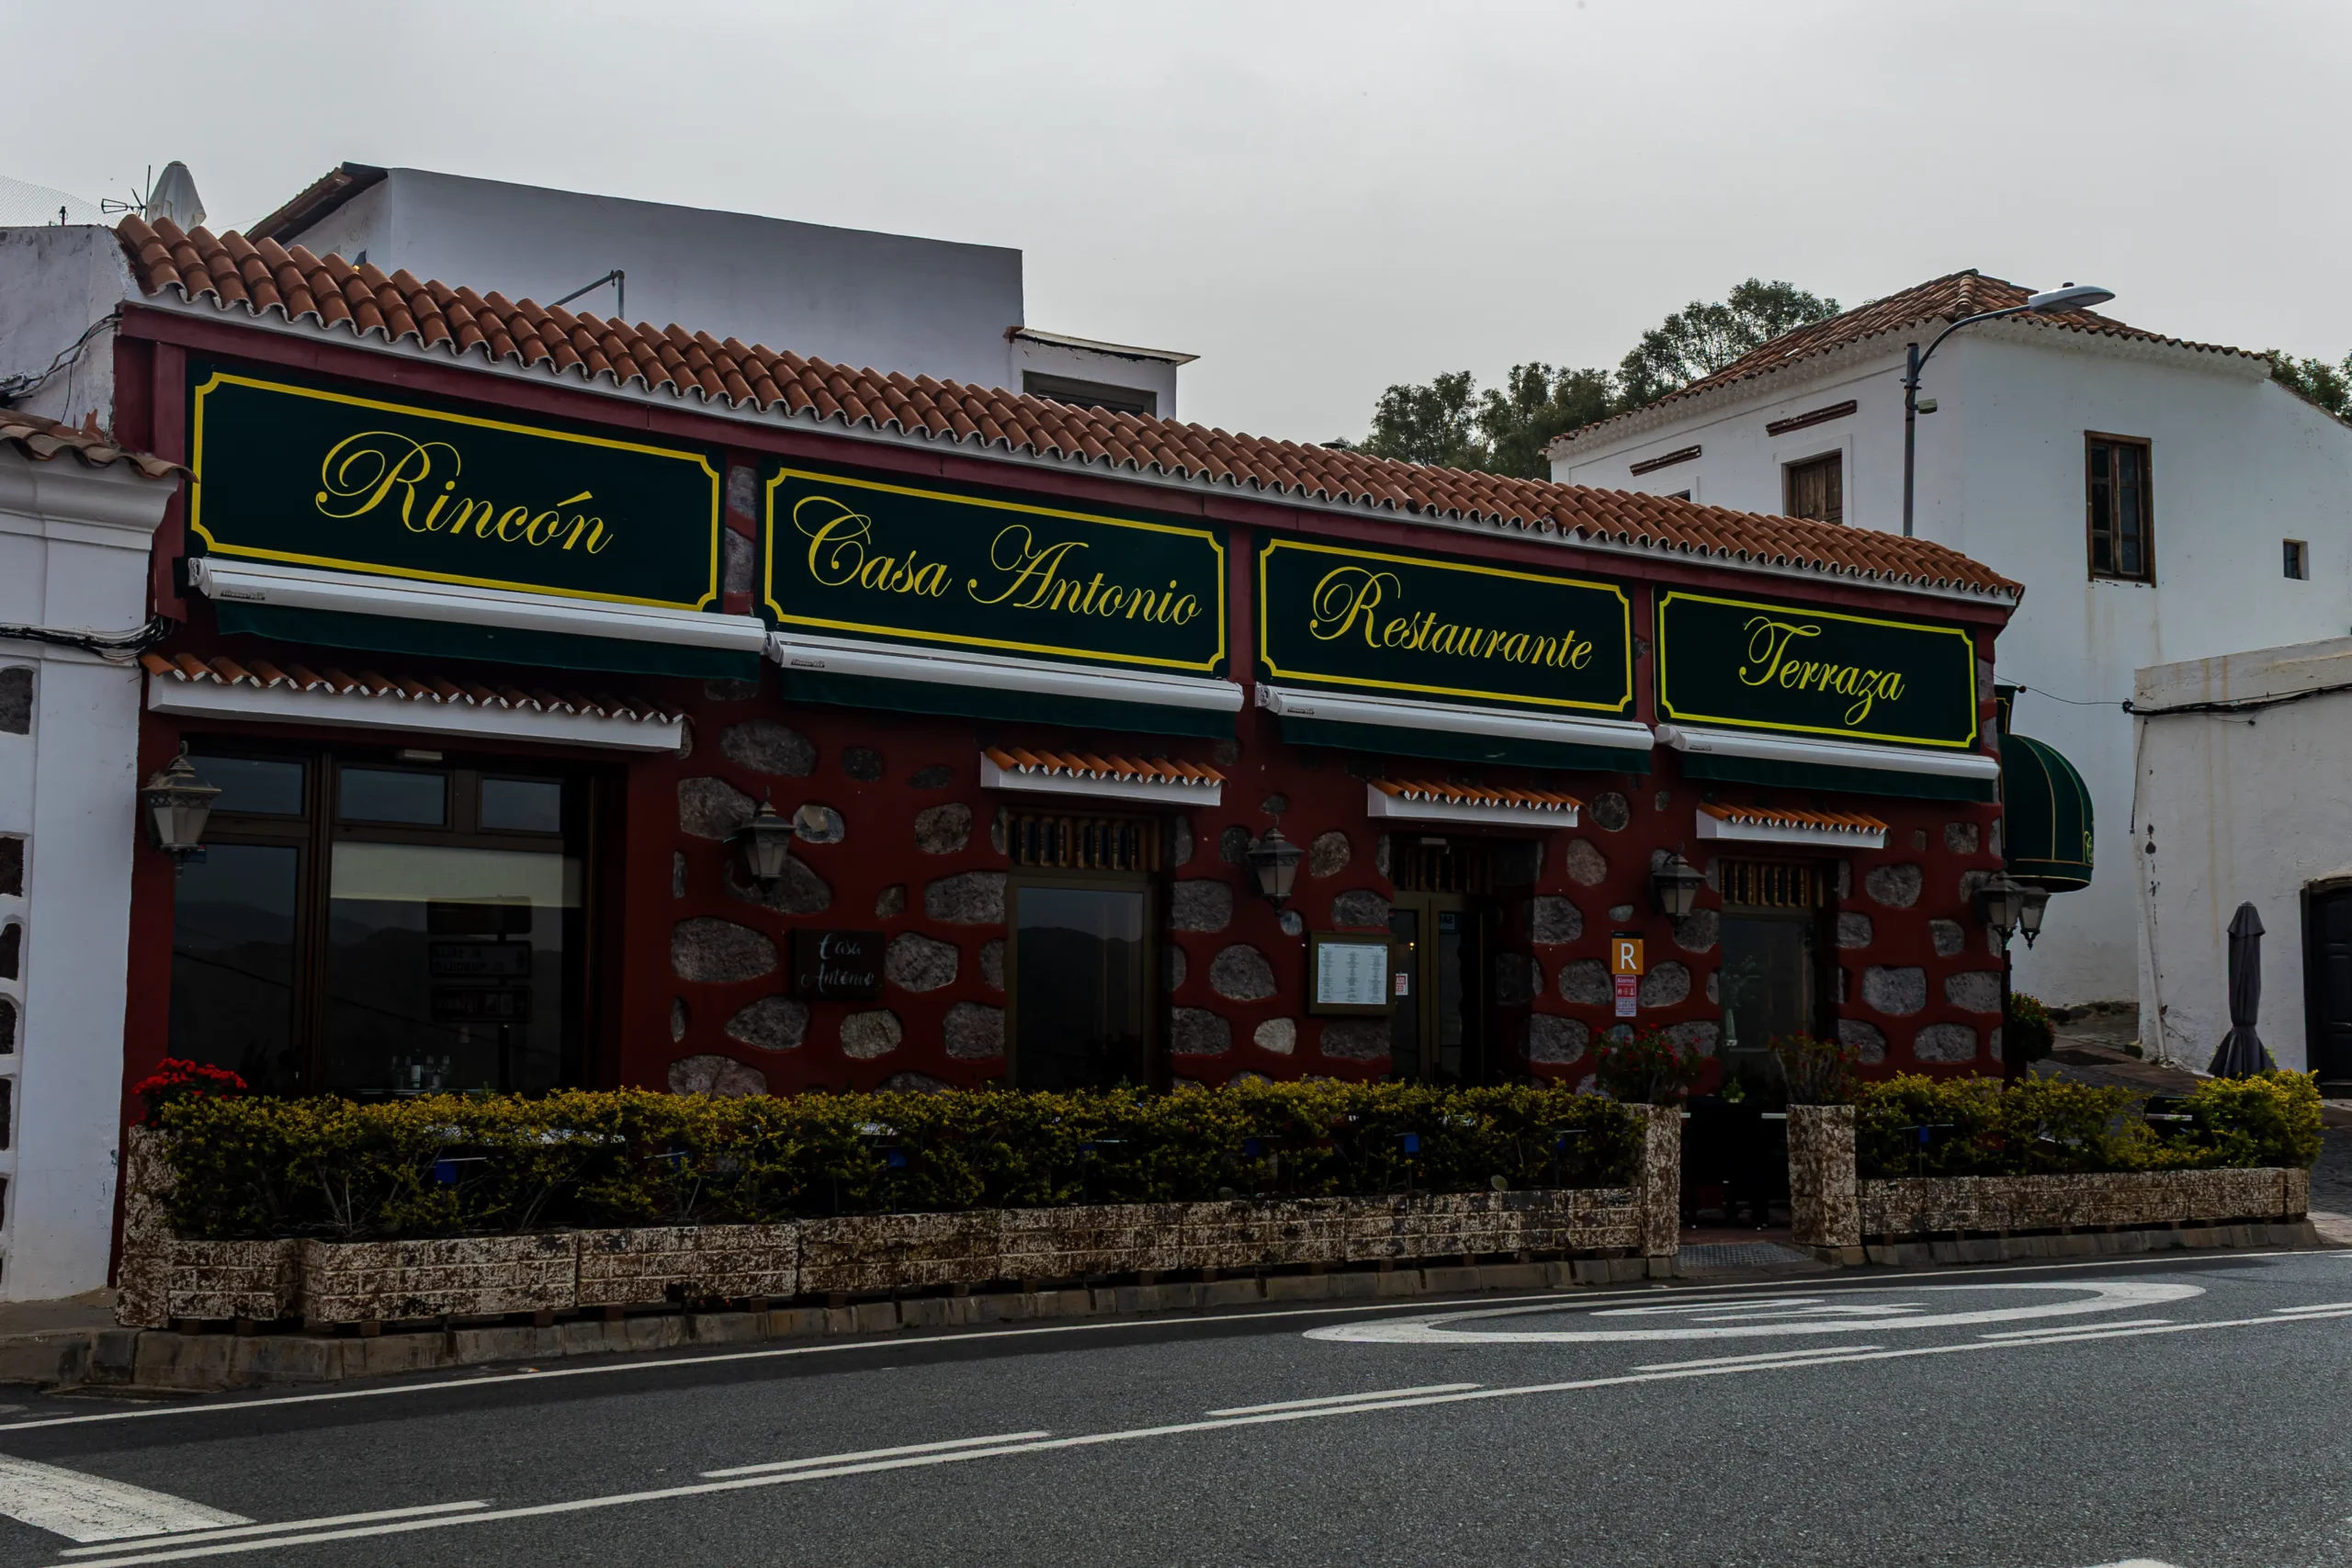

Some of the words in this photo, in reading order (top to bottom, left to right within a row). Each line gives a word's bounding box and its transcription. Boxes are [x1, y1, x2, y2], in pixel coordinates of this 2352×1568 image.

[315, 431, 614, 555] Rincón
[793, 496, 953, 597] Casa
[967, 525, 1203, 626] Antonio
[1309, 566, 1594, 671] Restaurante
[1738, 616, 1906, 726] Terraza
[819, 932, 861, 961] Casa
[1621, 942, 1637, 970] R
